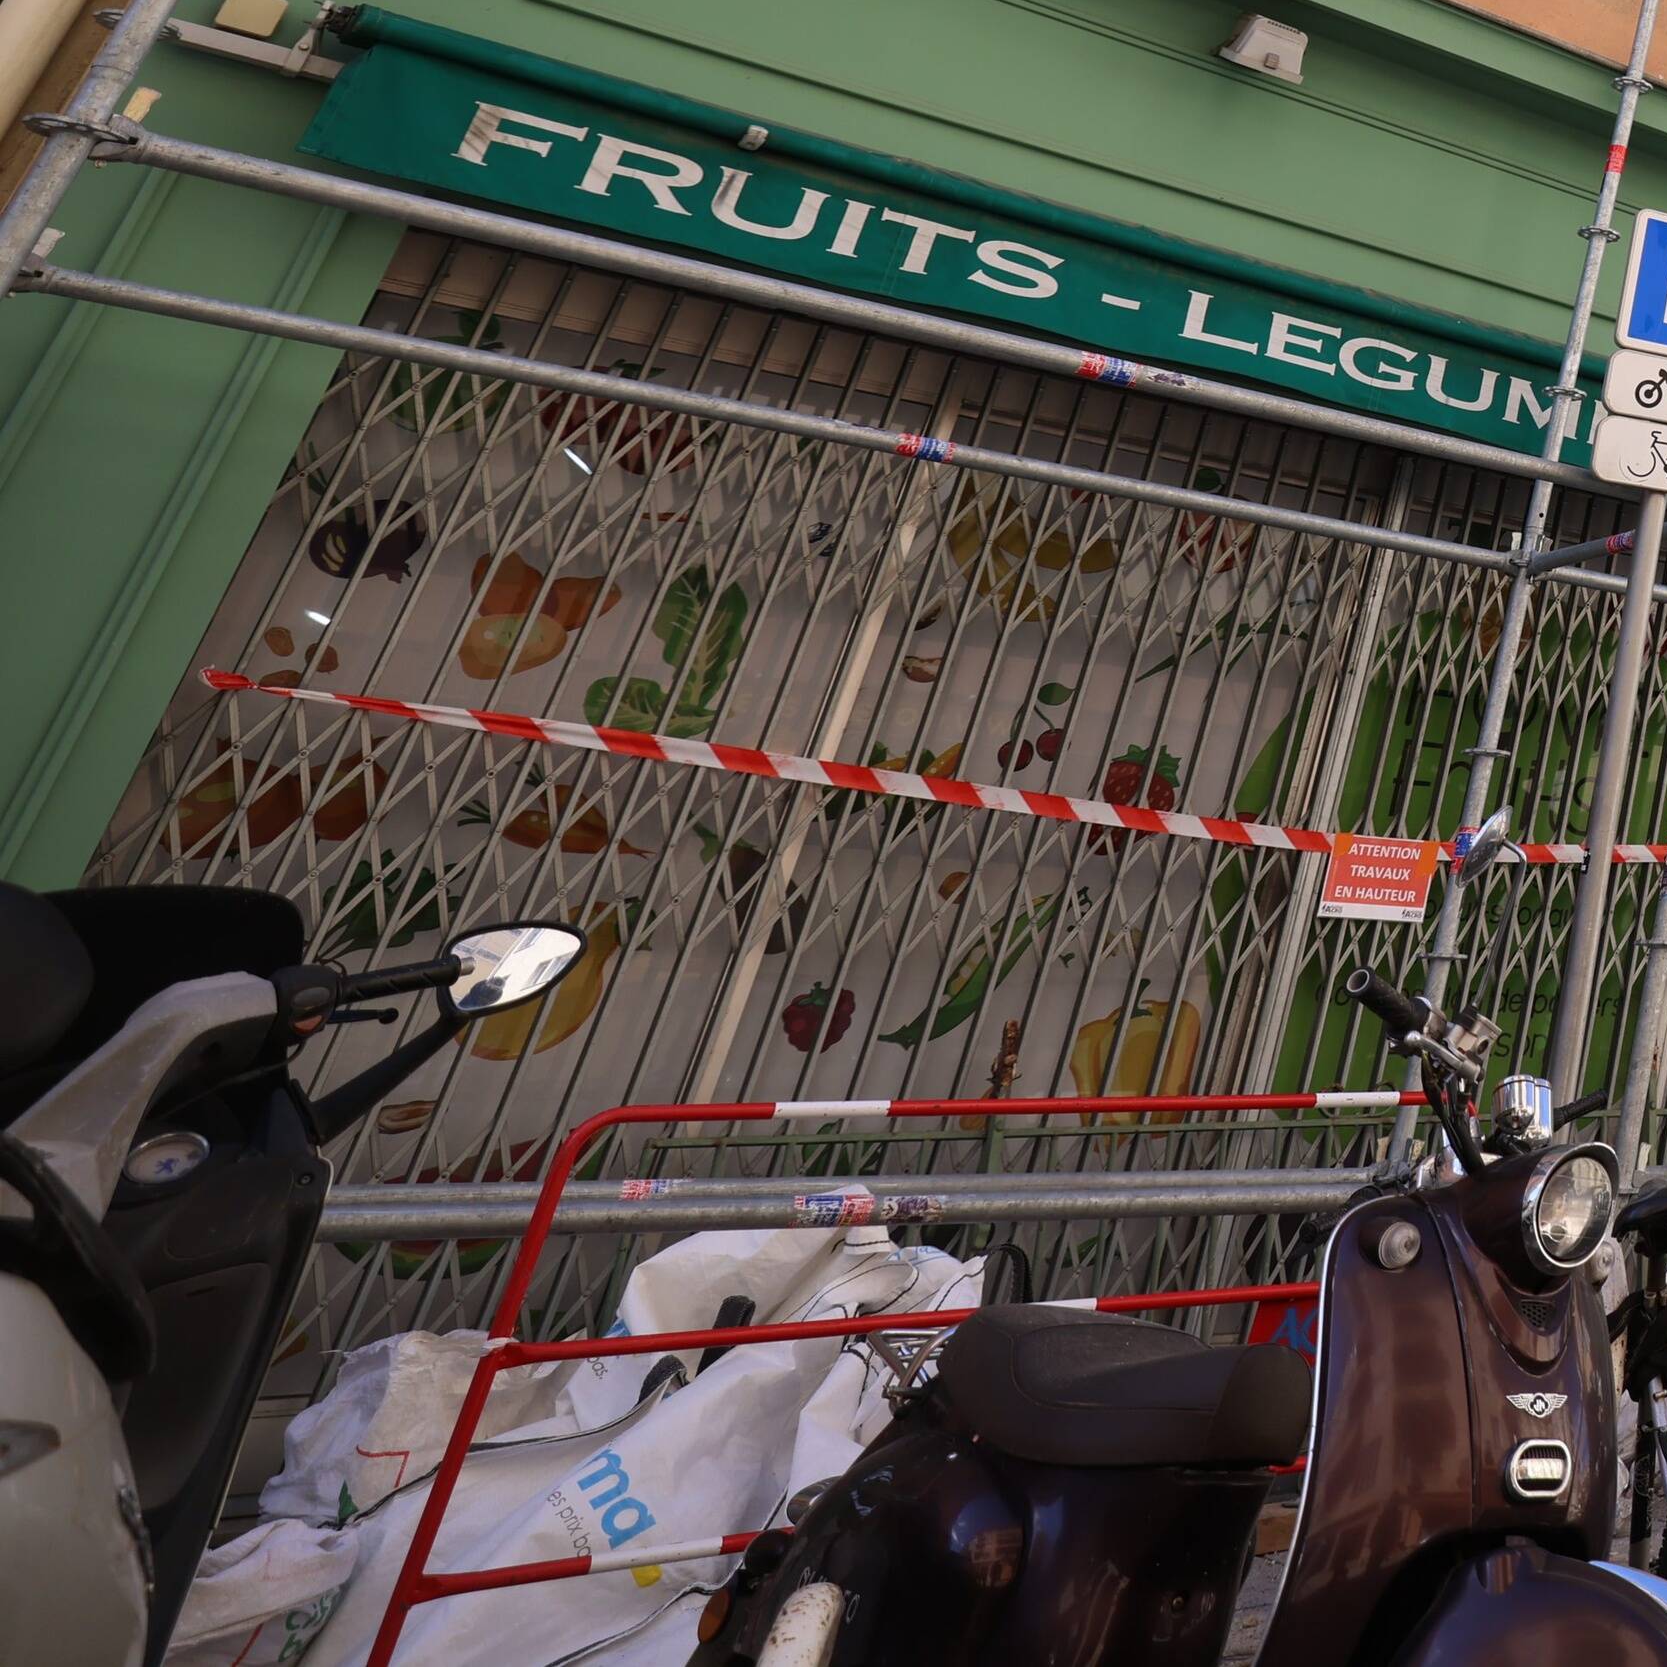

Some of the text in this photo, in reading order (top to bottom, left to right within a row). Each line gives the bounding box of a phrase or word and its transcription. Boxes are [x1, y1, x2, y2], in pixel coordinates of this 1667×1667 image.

[450, 100, 1066, 299] FRUITS
[1177, 289, 1609, 446] LEGUM
[1348, 843, 1421, 860] ATTENTION
[1351, 864, 1412, 881] TRAVAUX
[1334, 885, 1416, 903] EN HAUTEUR
[556, 1504, 584, 1536] prix
